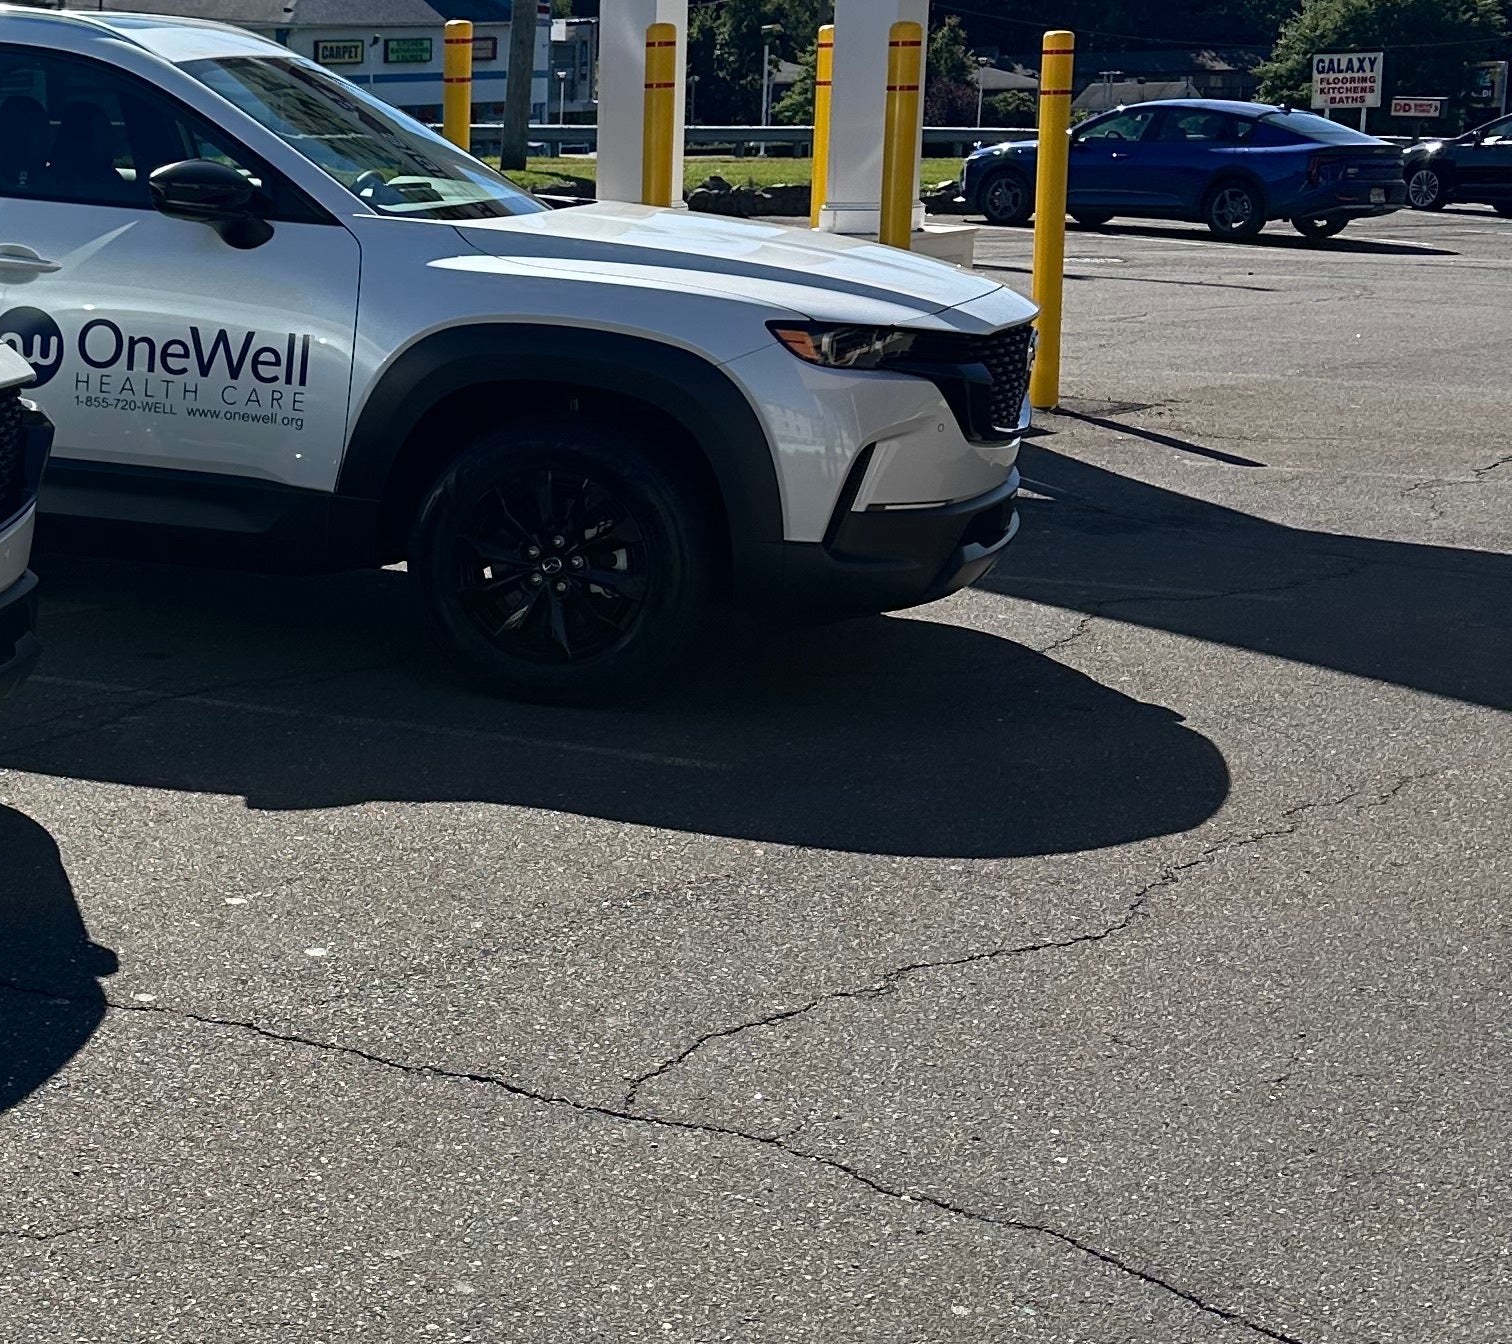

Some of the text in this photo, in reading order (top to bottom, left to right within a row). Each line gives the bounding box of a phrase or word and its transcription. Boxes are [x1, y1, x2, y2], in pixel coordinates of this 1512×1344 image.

[321, 45, 360, 61] CARPET
[1315, 56, 1378, 74] GALAXY
[1319, 76, 1377, 86] FLOORING
[1319, 85, 1376, 95] KITCHENS
[1329, 95, 1366, 104] BATHS
[77, 318, 311, 388] OneWell
[75, 372, 305, 413] HEALTH CARE
[74, 394, 304, 431] 1-855-720-WELL www.onewell.org
